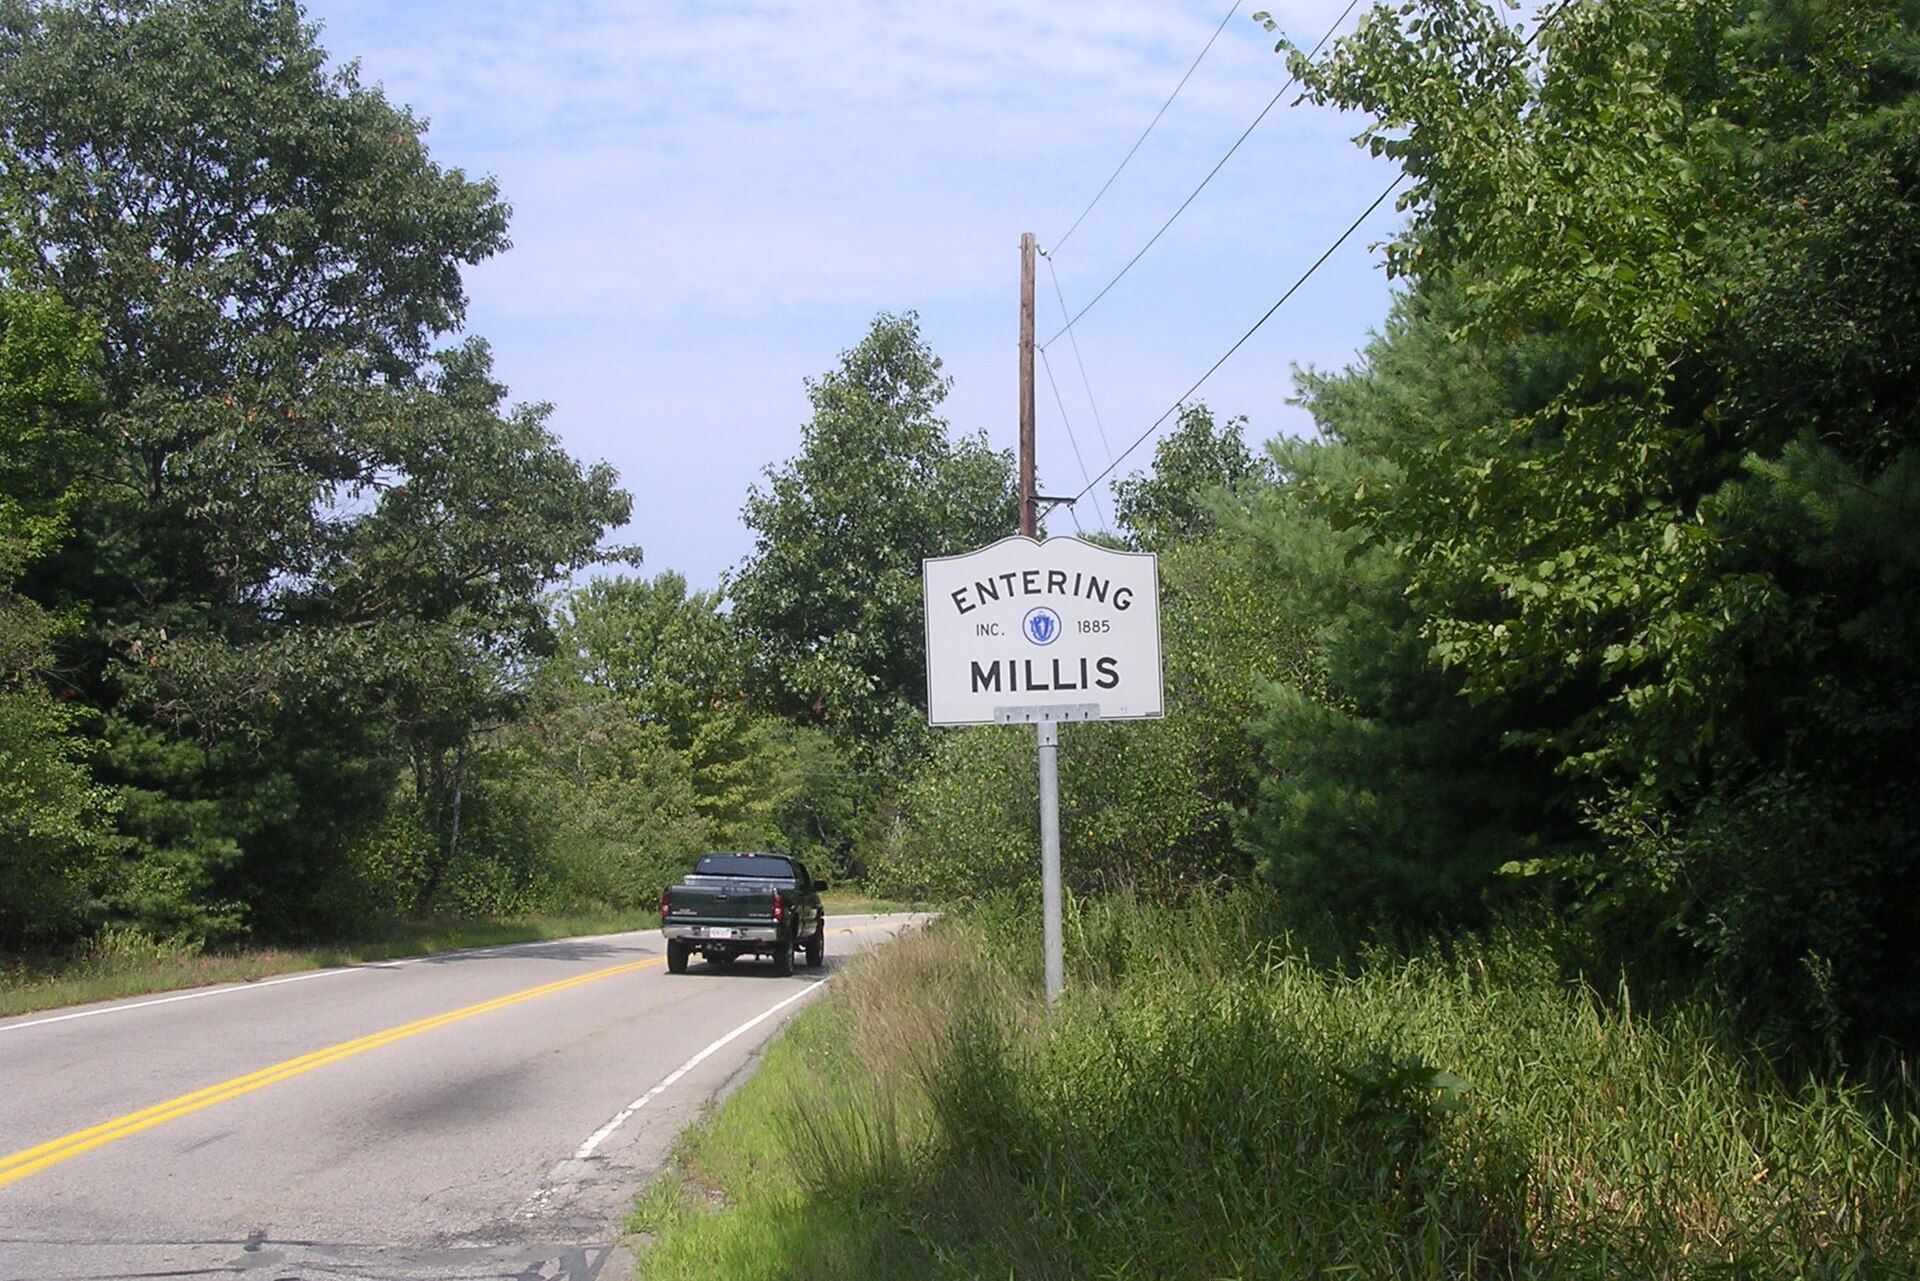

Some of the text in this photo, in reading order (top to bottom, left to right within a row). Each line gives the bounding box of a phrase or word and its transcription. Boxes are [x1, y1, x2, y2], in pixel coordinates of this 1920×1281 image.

[950, 570, 1134, 615] ENTERING
[976, 619, 1111, 637] INC. 1885
[970, 656, 1120, 693] MILLIS
